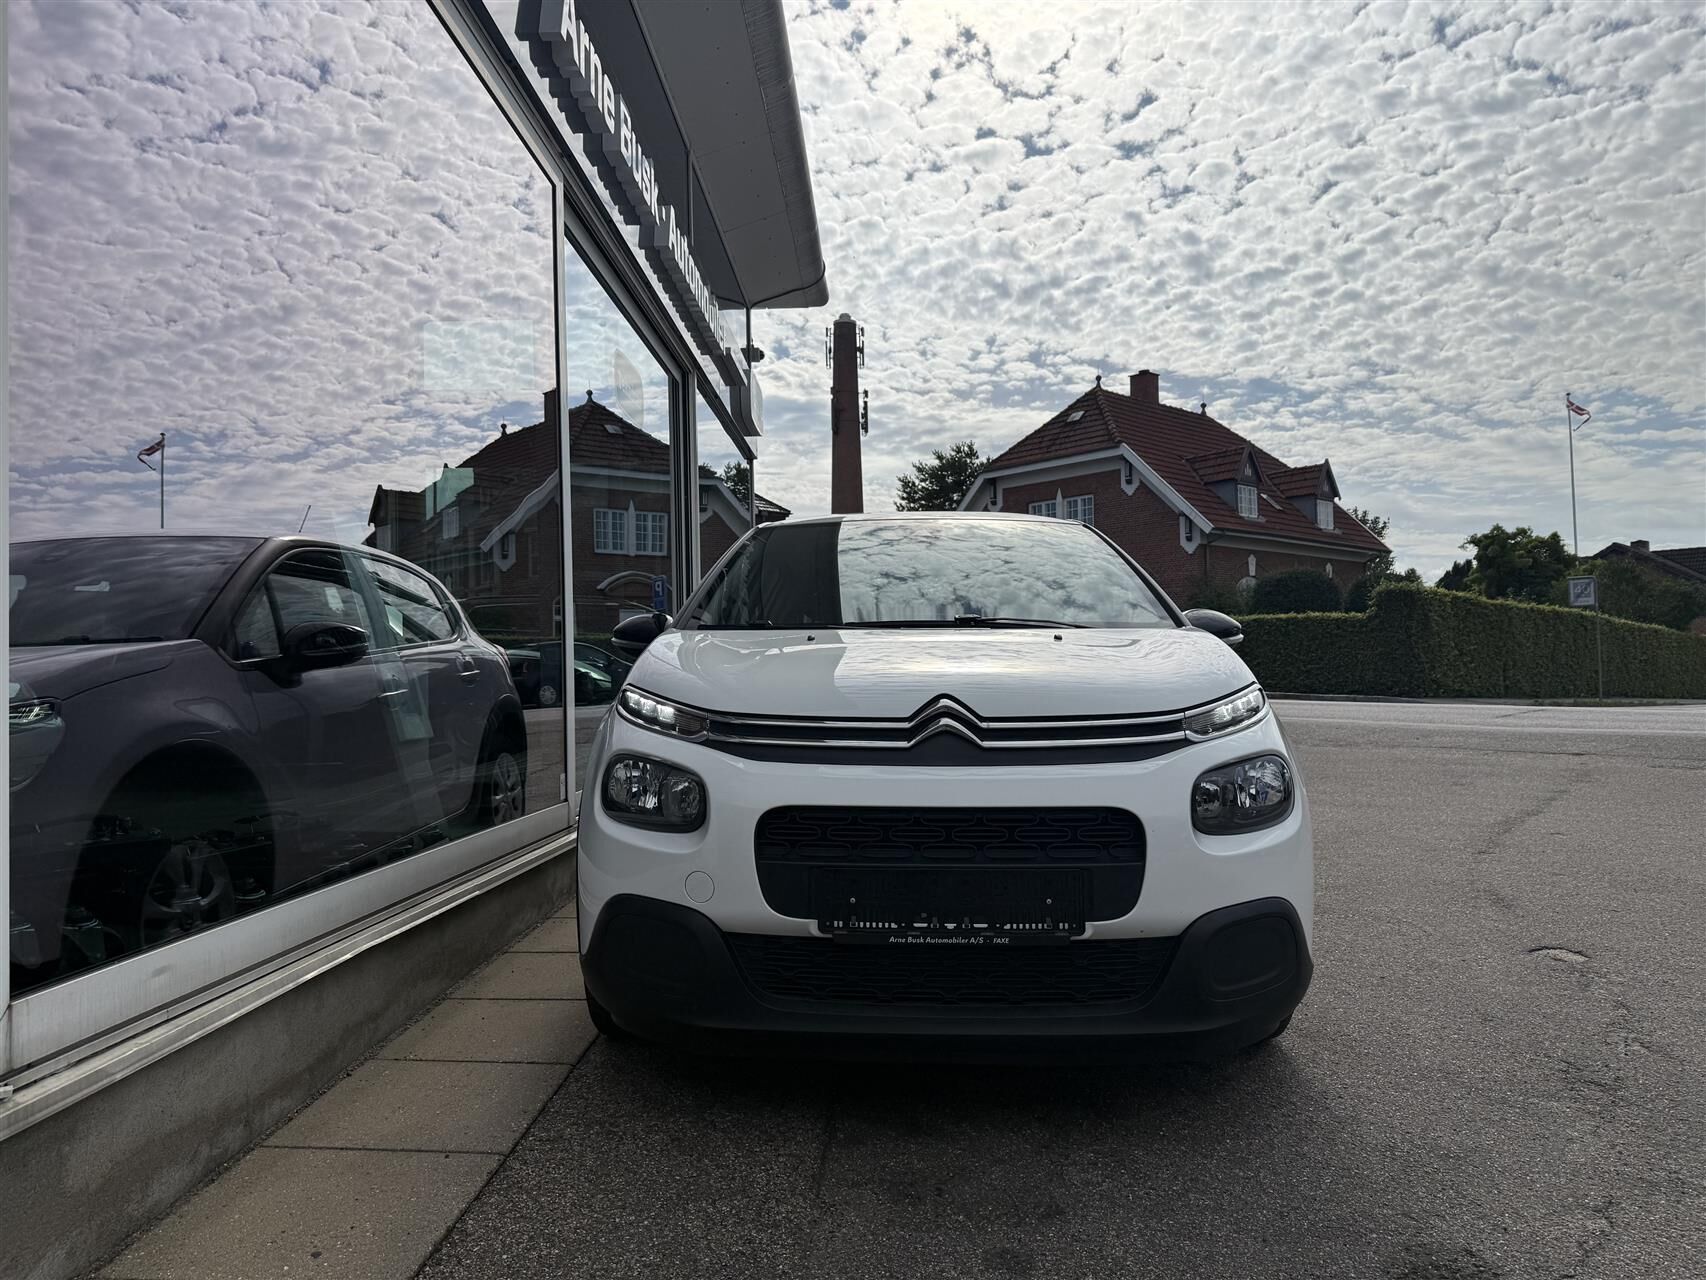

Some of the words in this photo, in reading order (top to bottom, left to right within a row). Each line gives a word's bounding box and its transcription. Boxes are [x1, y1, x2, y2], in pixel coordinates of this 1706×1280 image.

[560, 0, 616, 134] Arne
[620, 95, 660, 226] Busk
[925, 936, 968, 944] Automobiler
[969, 936, 984, 944] A/S
